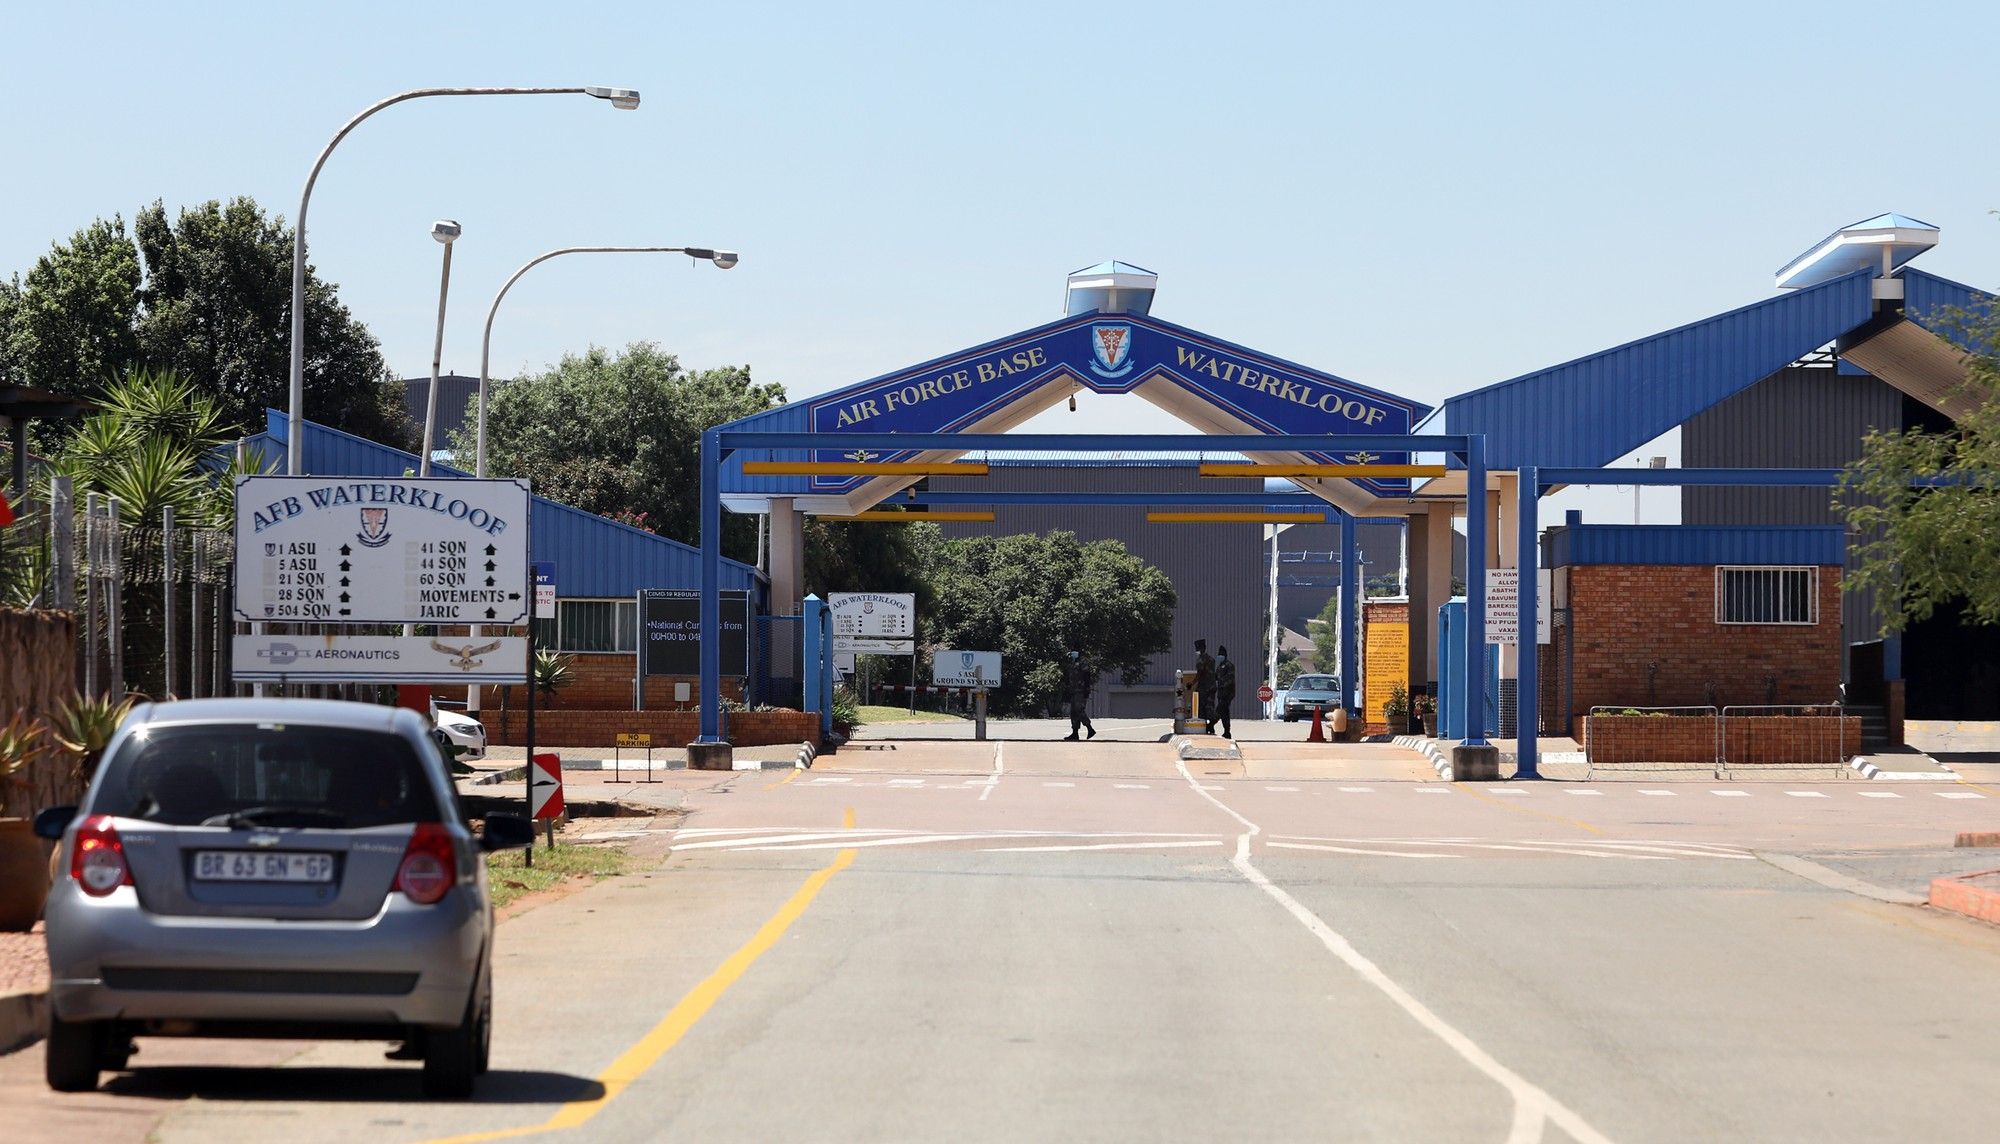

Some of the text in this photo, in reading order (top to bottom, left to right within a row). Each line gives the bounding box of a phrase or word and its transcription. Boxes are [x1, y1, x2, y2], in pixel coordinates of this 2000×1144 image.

[836, 346, 1387, 429] AIR FORCE BASE WATERKLOOF
[253, 484, 507, 536] AFB WATERKLOOF
[288, 543, 316, 555] ASU
[420, 541, 467, 556] 41 SQN
[279, 558, 317, 571] 5 ASU
[420, 557, 467, 572] 44 SQN
[279, 572, 325, 587] 21 SQN
[420, 572, 466, 588] 60 SQN
[278, 588, 325, 604] 28 SQN
[420, 590, 505, 603] MOVEMENTS
[833, 594, 907, 611] AFB WATERKLOOF
[278, 604, 331, 619] 504 SQN
[420, 606, 460, 618] JARIC
[650, 620, 683, 629] National
[685, 620, 700, 629] Cur
[724, 621, 742, 630] from
[650, 632, 677, 641] 00H00
[678, 633, 687, 641] to
[315, 649, 400, 660] AERONAUTICS
[201, 855, 330, 878] BR 63 GN GP
